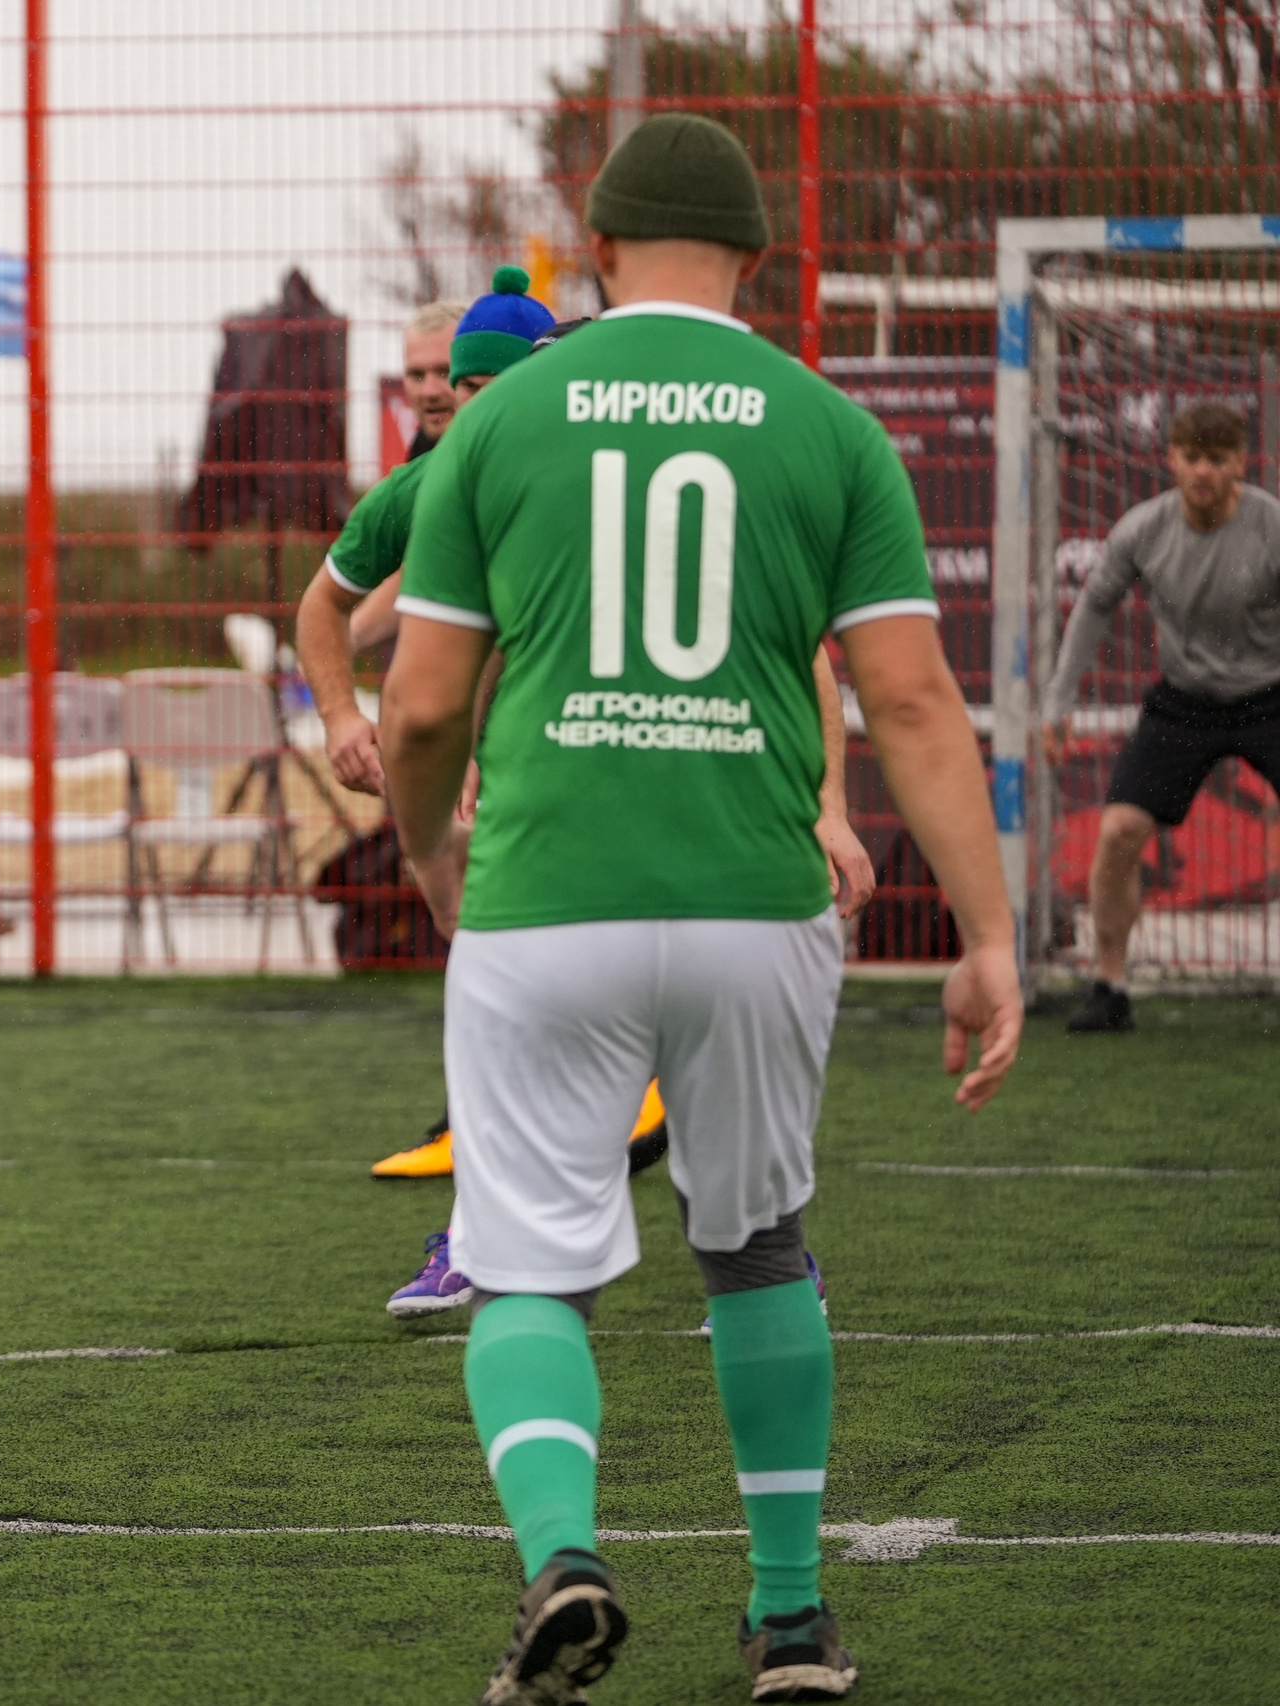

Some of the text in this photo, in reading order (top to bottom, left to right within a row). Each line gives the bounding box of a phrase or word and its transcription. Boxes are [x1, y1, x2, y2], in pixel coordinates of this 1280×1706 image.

[566, 379, 767, 426] БИРЮКОВ
[590, 448, 737, 682] 10
[561, 691, 751, 725] АГРОНОМЫ
[544, 721, 765, 753] ЧЕРНОЗЕМЬЯ
